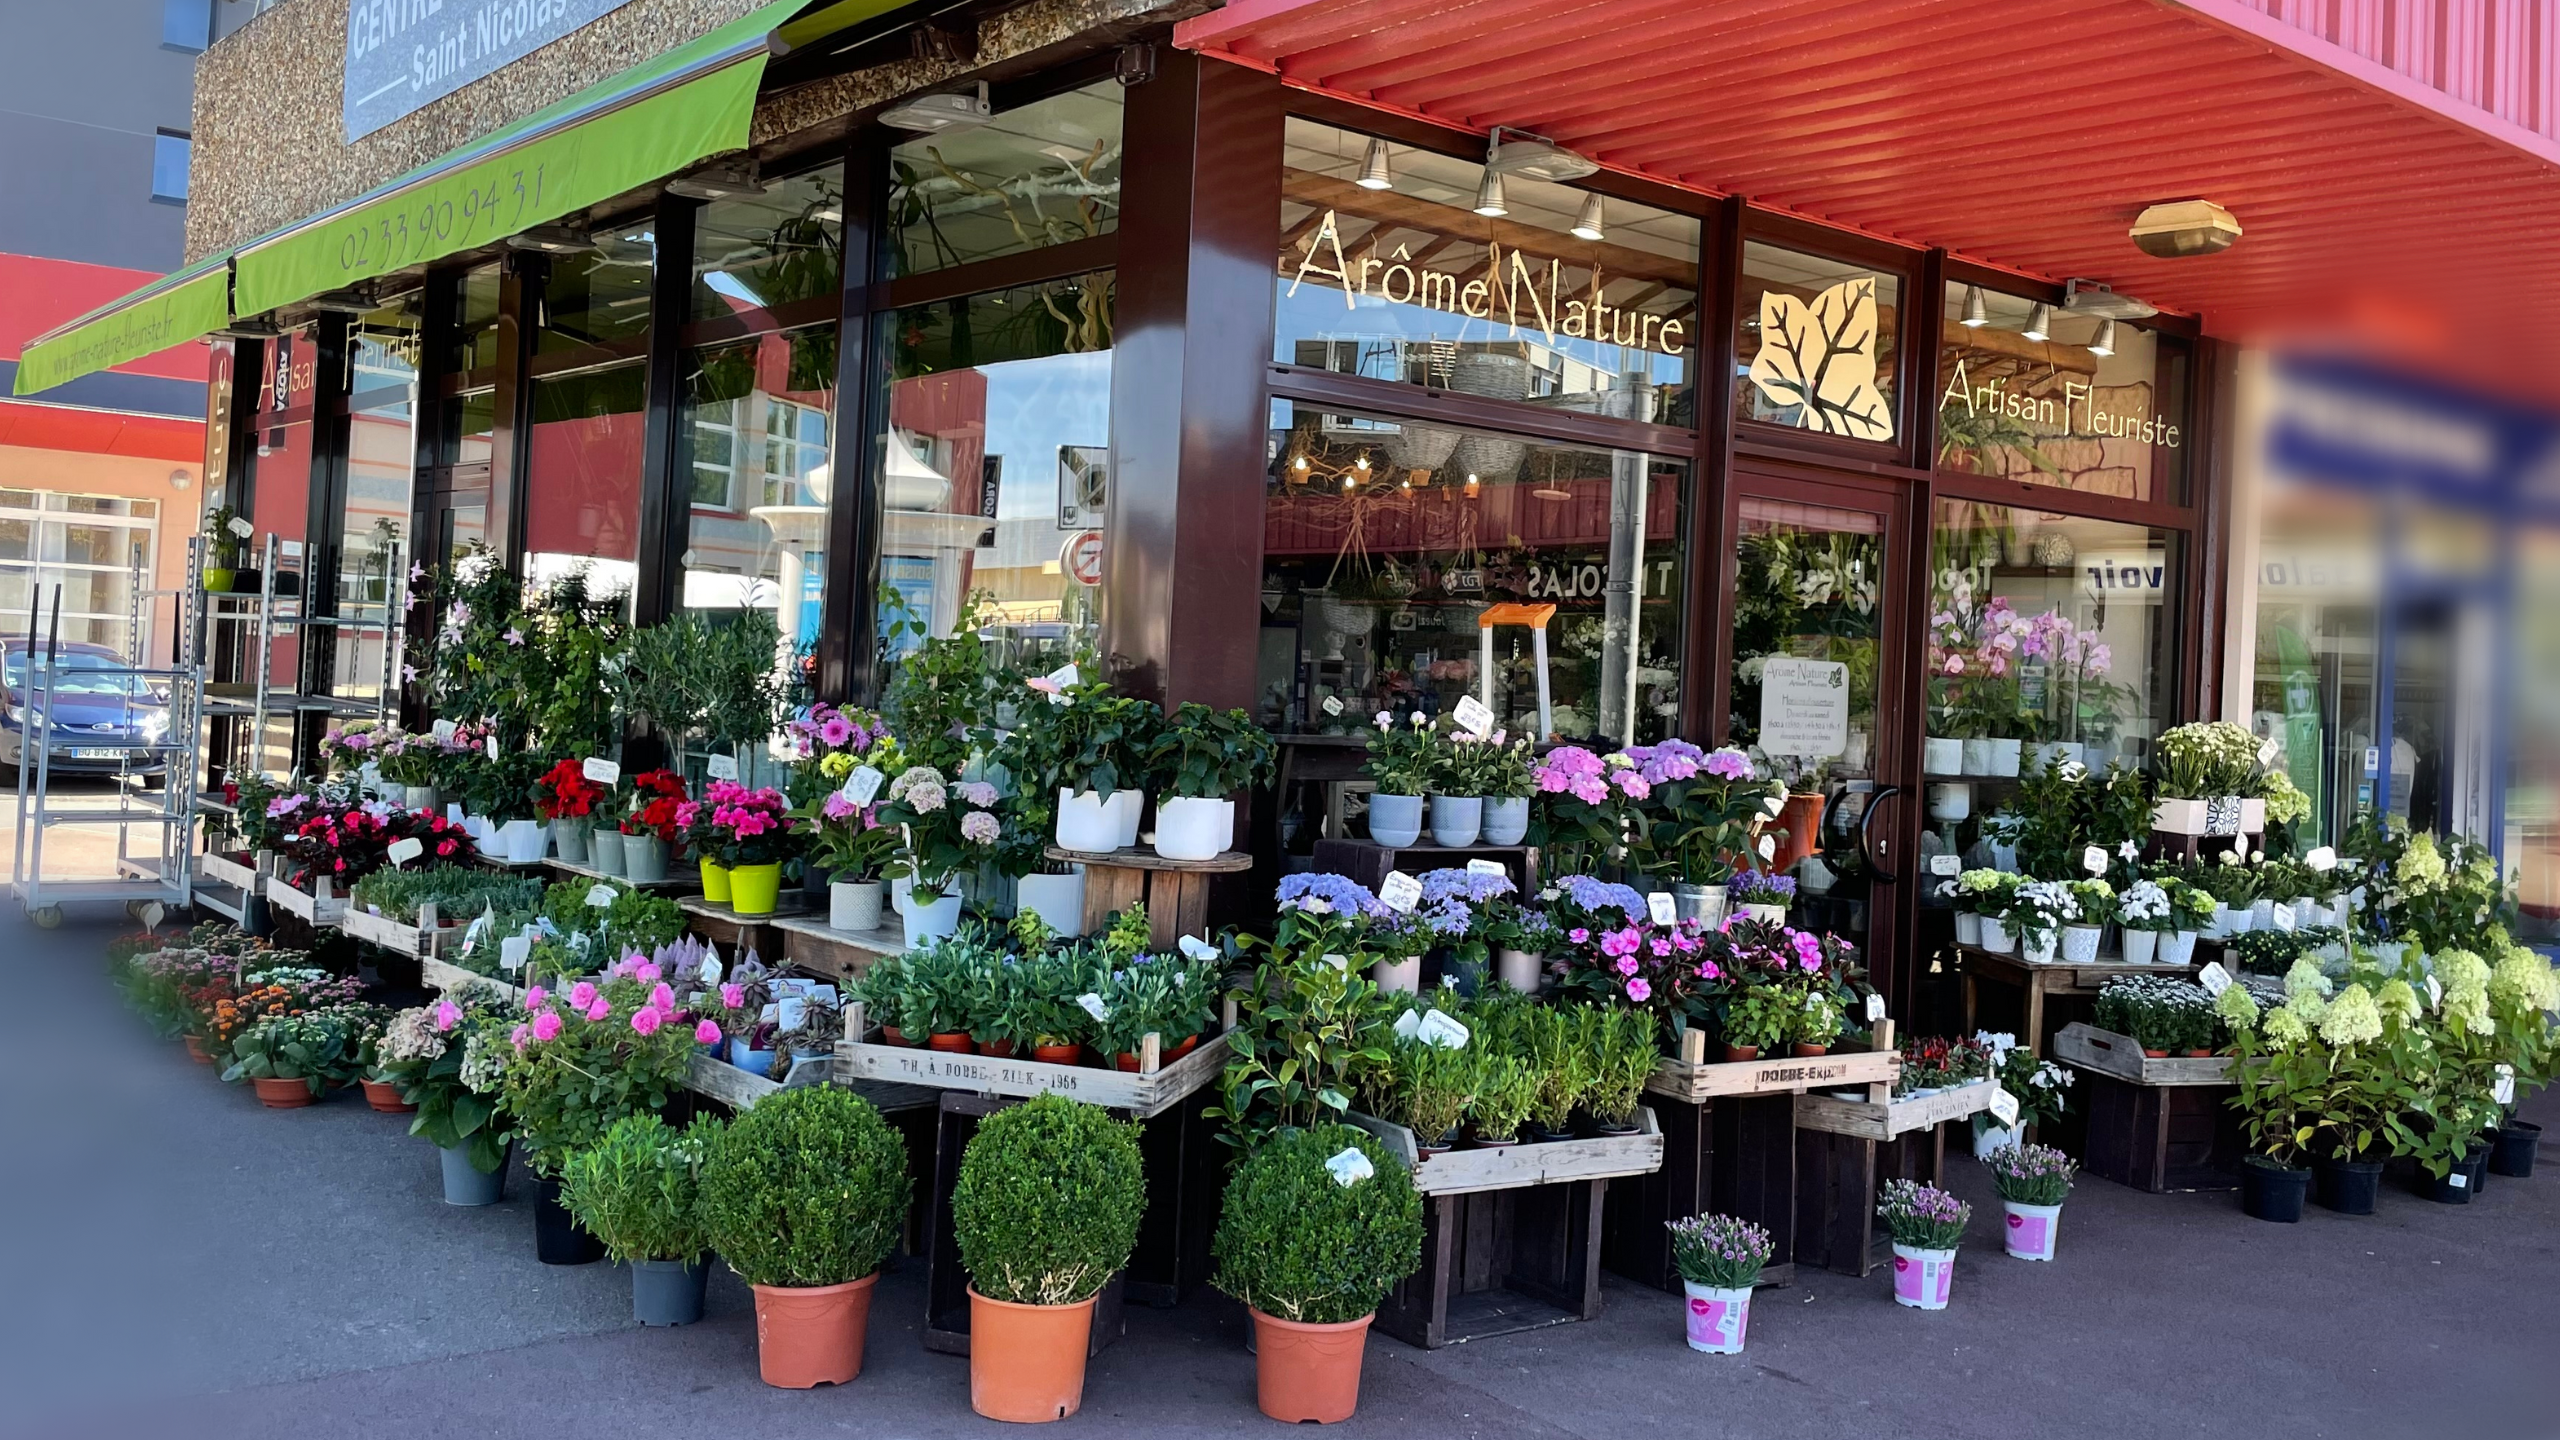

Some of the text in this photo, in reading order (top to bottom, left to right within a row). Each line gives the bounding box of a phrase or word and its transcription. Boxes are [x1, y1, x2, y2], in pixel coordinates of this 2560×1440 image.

[411, 0, 567, 92] Saint Nicolas
[340, 163, 544, 270] 02 33 90 94 31
[1286, 208, 1686, 355] Arôme Nature
[1939, 359, 2180, 448] Artisan Fleuriste
